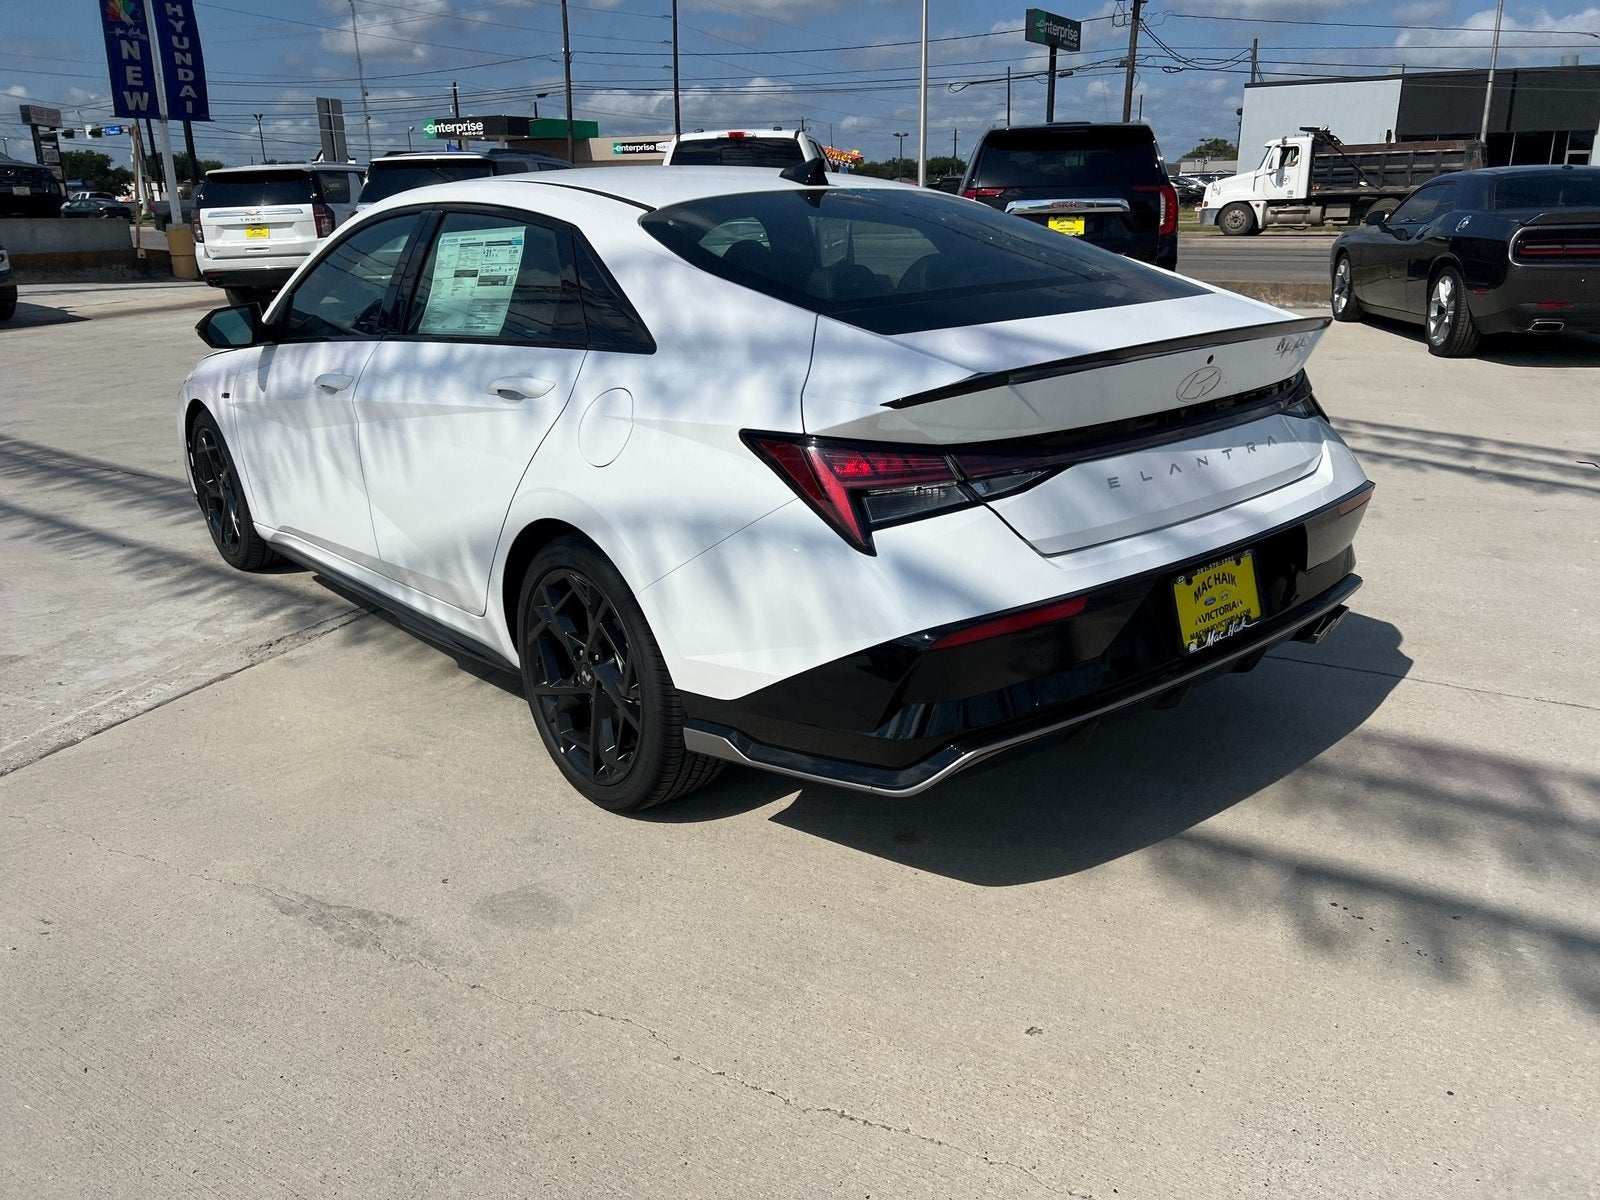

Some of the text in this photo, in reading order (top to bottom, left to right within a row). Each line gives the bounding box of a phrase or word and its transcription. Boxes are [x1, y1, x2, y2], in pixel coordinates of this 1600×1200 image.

[1036, 19, 1078, 42] enterprise
[165, 3, 197, 114] HYUNDAI
[120, 39, 149, 112] NEW
[423, 120, 484, 135] enterprise
[613, 143, 655, 152] enterprise
[1107, 434, 1278, 489] ELANTRA
[1194, 576, 1213, 604] MAC
[1213, 572, 1237, 587] HAIK
[1200, 600, 1238, 623] VICTORIA
[1206, 630, 1225, 647] Mac
